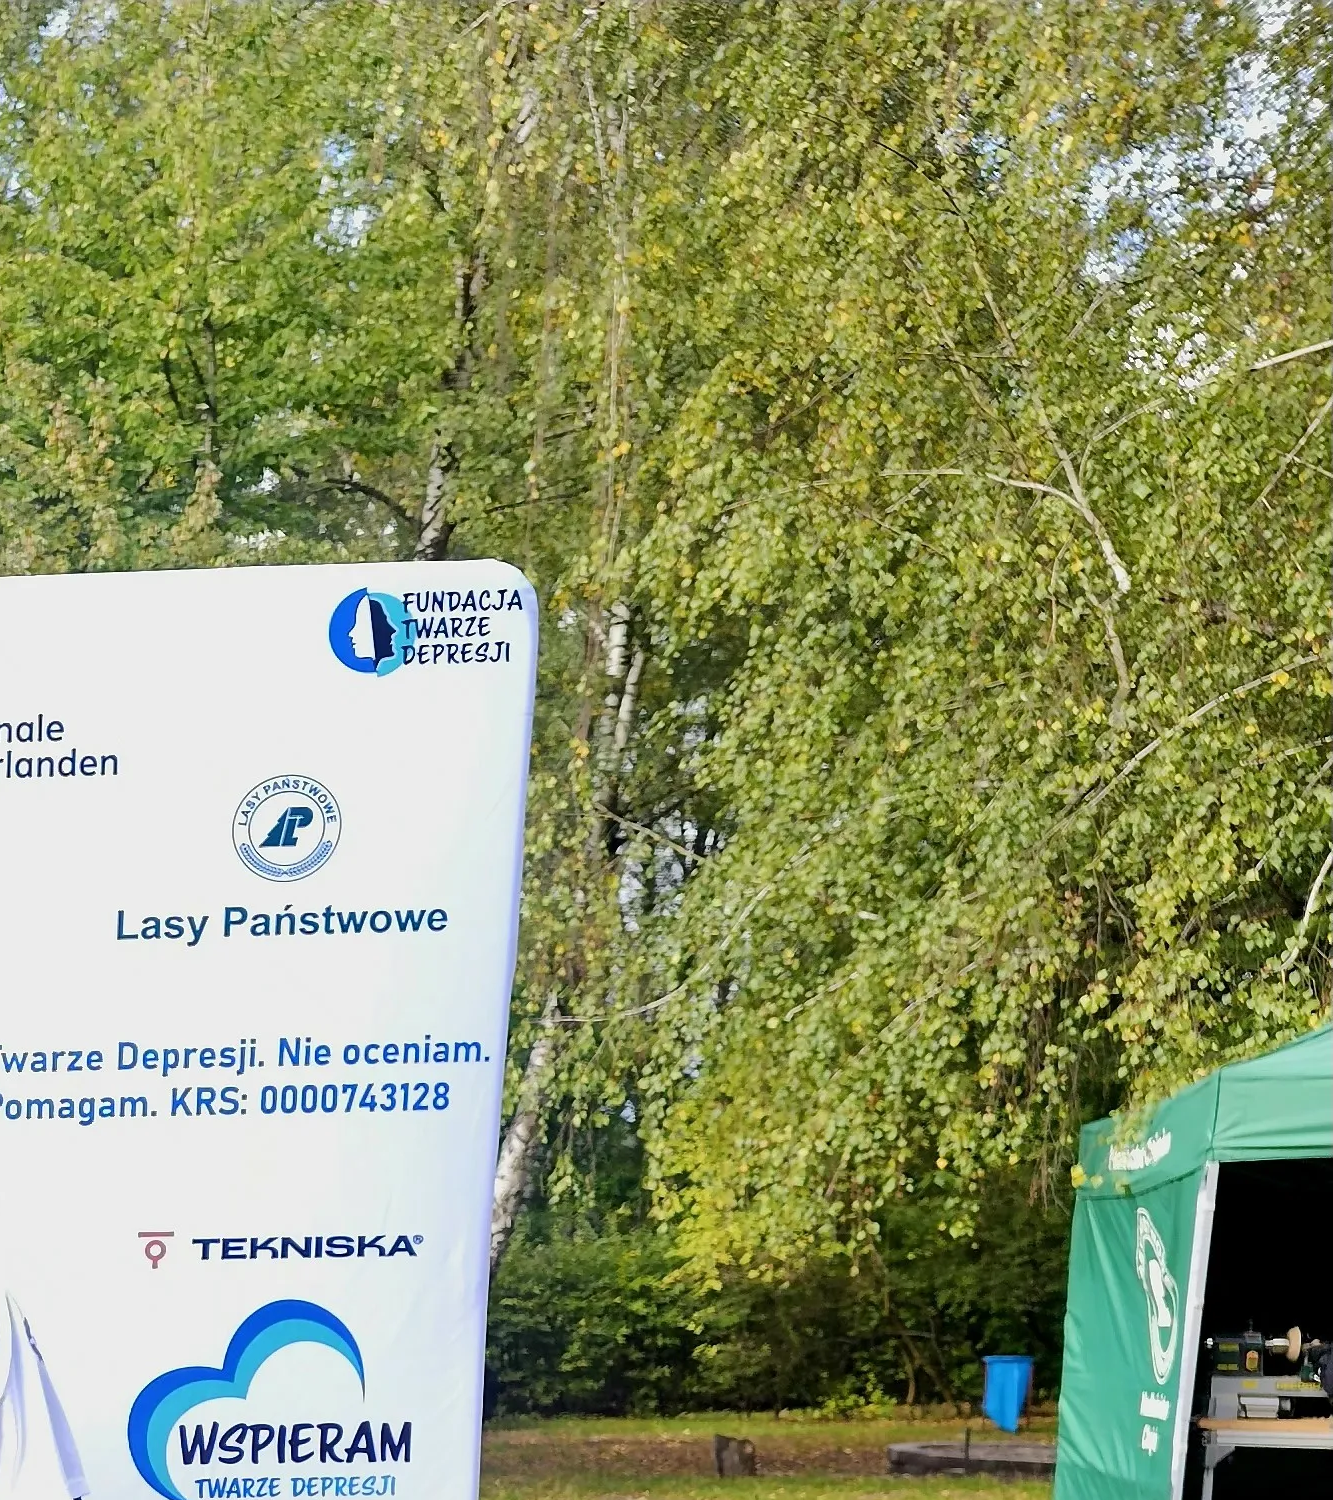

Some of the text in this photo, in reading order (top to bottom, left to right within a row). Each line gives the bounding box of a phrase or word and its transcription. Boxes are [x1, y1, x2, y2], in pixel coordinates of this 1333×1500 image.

[401, 589, 523, 614] FUNDACJA
[403, 616, 492, 640] TWARZE
[401, 641, 512, 666] DEPRESJI
[237, 792, 261, 826] LASY
[116, 903, 449, 948] Lasy Państwowe
[117, 1041, 266, 1078] Depresji.
[278, 1038, 332, 1068] Nie
[341, 1034, 492, 1067] oceniam.
[170, 1086, 248, 1117] KRS:
[259, 1082, 450, 1115] 0000743128
[178, 1420, 413, 1466] WSPIERAM
[194, 1476, 397, 1499] TWARZE DEPRESJI
